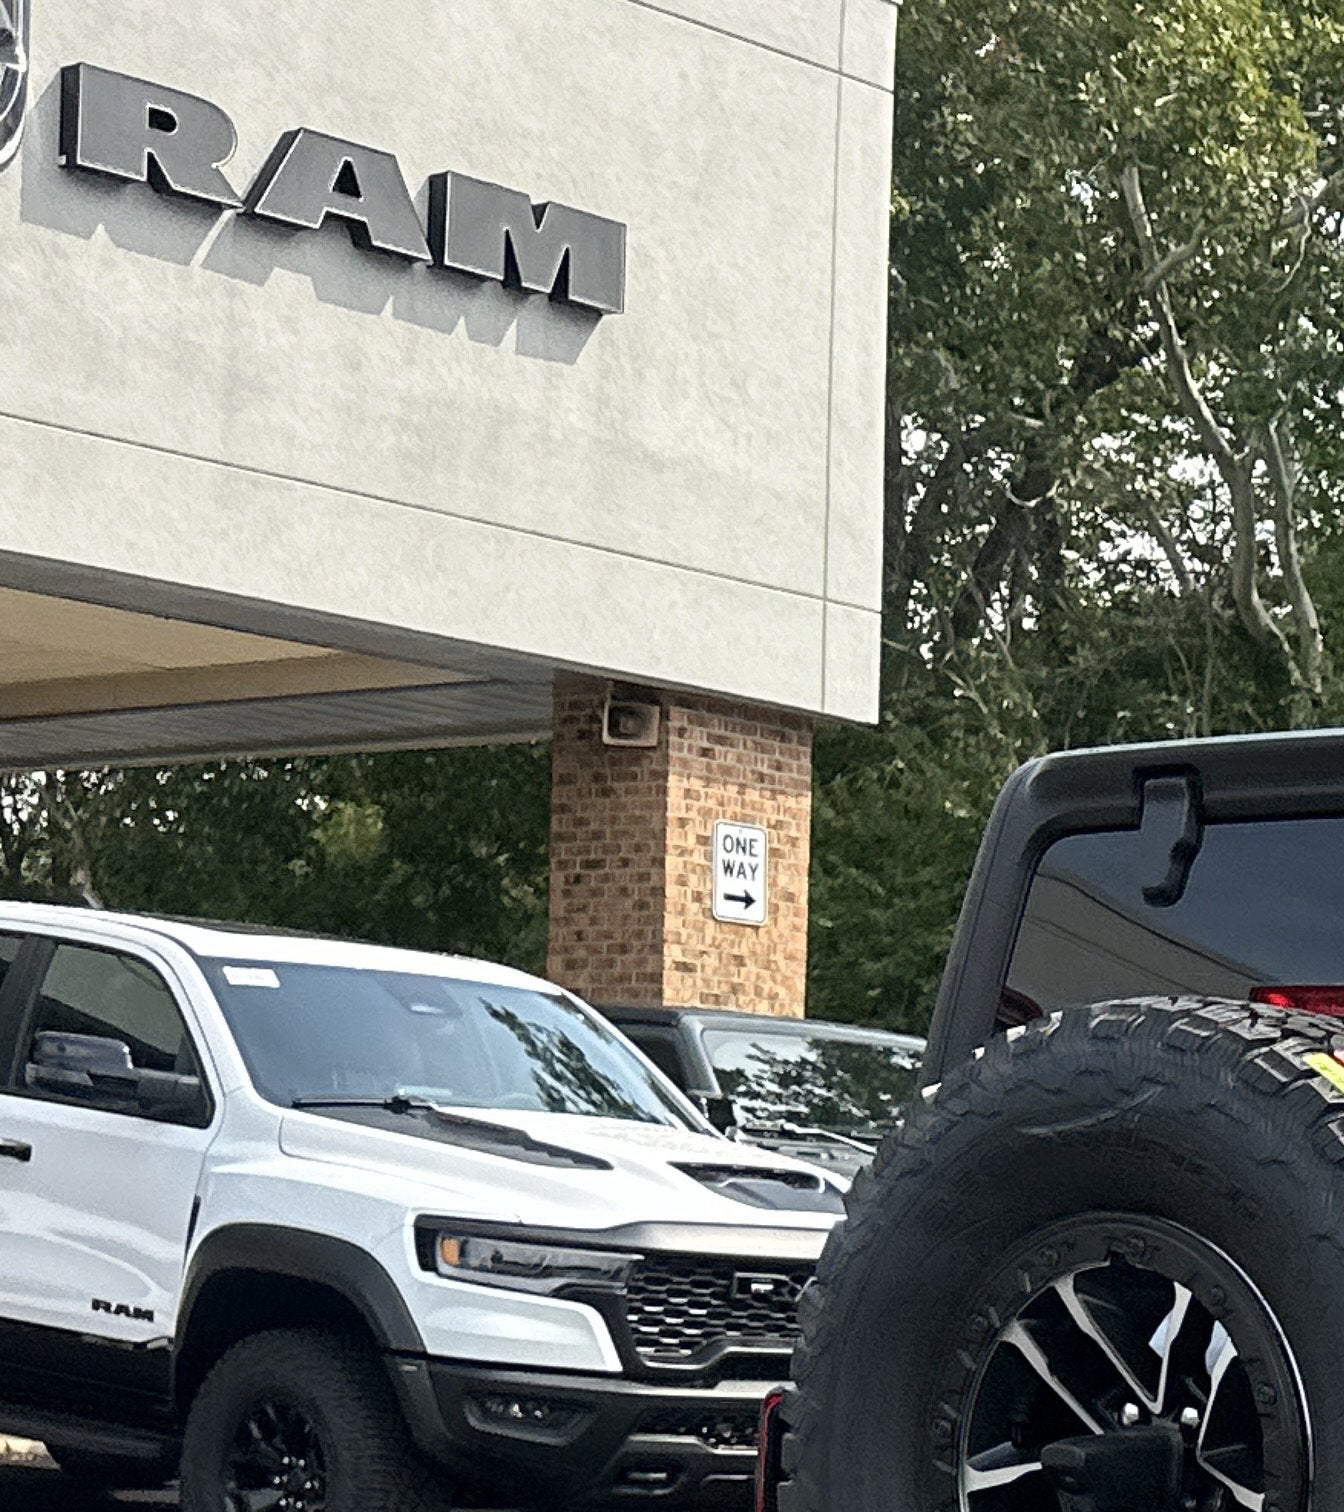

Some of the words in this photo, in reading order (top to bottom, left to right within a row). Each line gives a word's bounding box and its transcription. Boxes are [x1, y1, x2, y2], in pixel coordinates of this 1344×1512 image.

[60, 62, 627, 314] RAM
[722, 834, 758, 857] ONE
[722, 859, 760, 882] WAY
[92, 1298, 154, 1323] RAM
